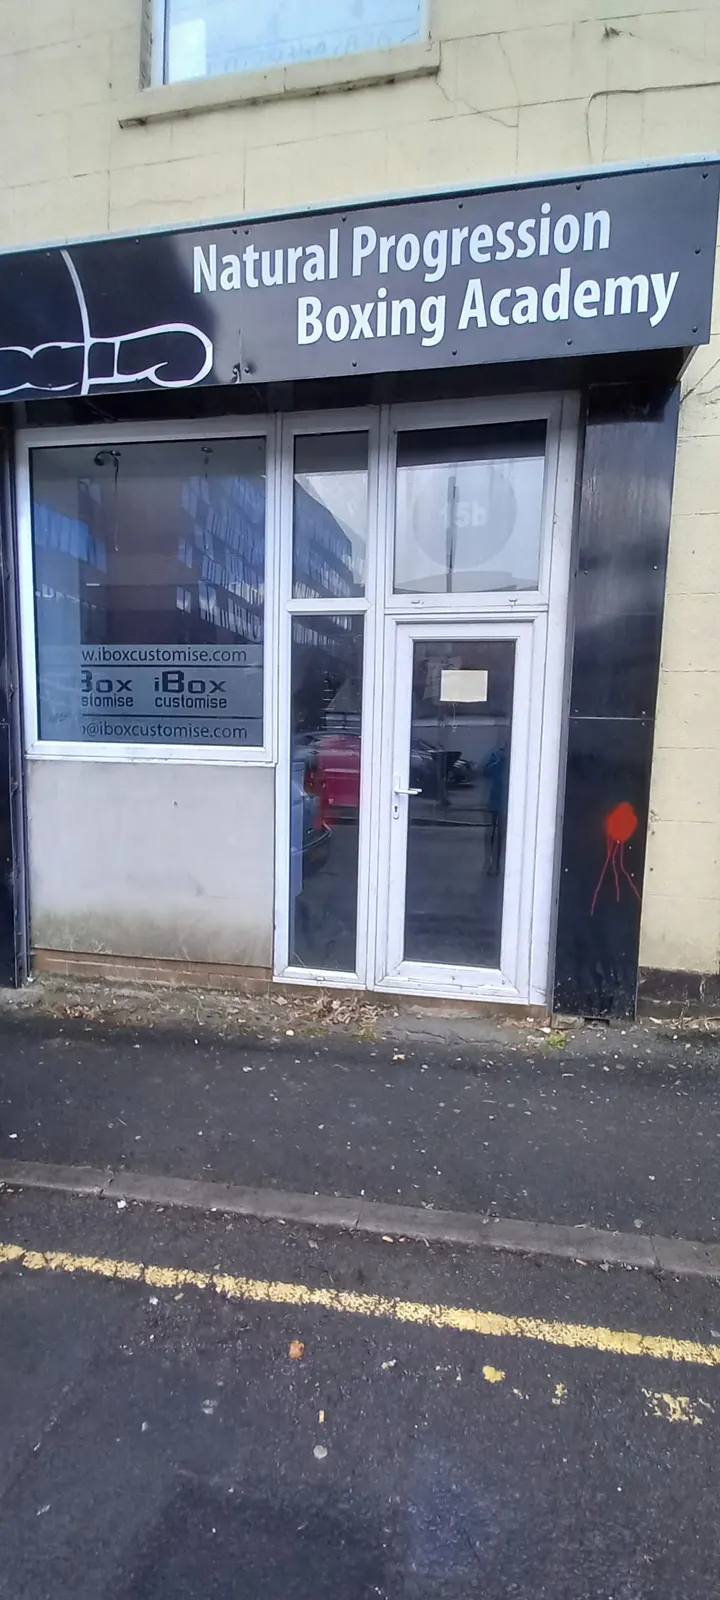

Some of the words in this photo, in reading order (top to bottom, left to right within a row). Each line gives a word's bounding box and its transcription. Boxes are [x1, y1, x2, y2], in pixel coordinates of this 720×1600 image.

[192, 228, 339, 294] Natural
[351, 202, 611, 283] Progression
[296, 288, 447, 348] Boxing
[457, 267, 680, 328] Academy
[81, 646, 247, 662] w.iboxcustomise.com
[154, 669, 227, 694] iBox
[81, 693, 134, 708] stomise
[154, 694, 228, 709] customise
